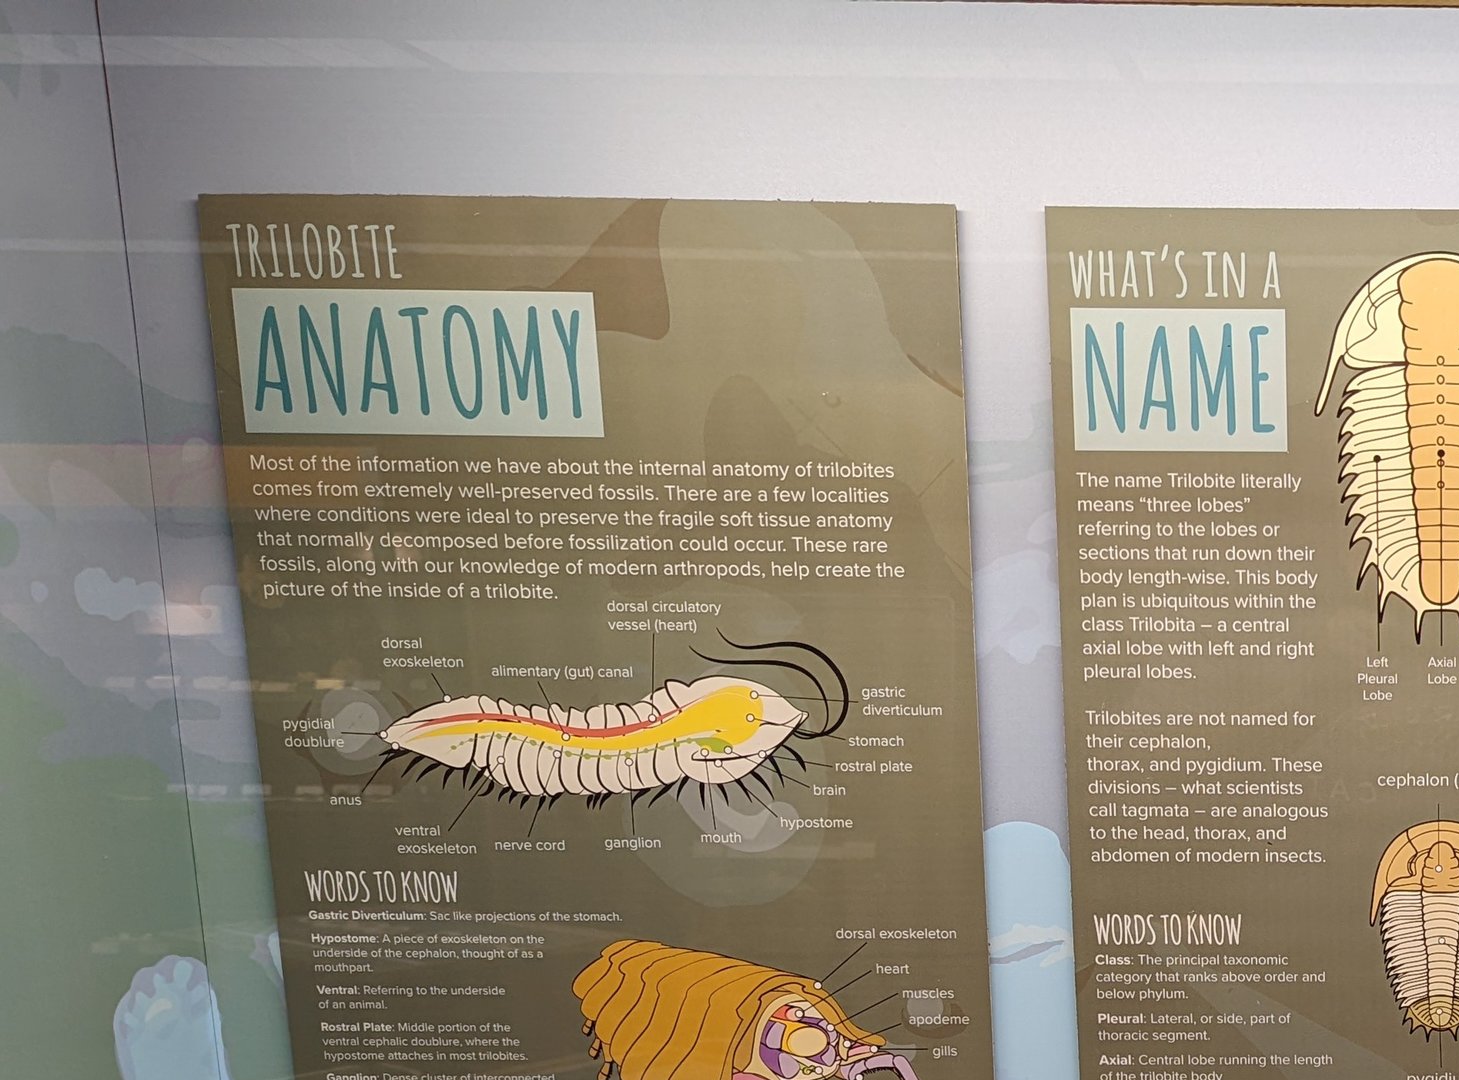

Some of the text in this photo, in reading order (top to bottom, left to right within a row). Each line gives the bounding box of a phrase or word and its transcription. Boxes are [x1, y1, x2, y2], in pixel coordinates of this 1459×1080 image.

[226, 223, 402, 279] TRILOBITE
[1069, 245, 1280, 299] WHAT'S IN A
[252, 303, 581, 423] ANATOMY
[1085, 322, 1275, 435] NAME
[250, 455, 894, 480] Most of the information we have about the internal anatomy of trilobites
[1076, 472, 1301, 492] The name Trilobite literally
[1078, 500, 1134, 511] means
[1079, 521, 1280, 540] referring to the lobes or
[607, 600, 721, 615] dorsal circulatory
[608, 619, 696, 633] vessel (heart)
[381, 637, 422, 648] dorsal
[383, 656, 463, 667] exoskeleton
[1367, 657, 1388, 667] Left
[1428, 657, 1456, 667] Axial
[492, 665, 632, 680] alimentary (gut) canal
[1358, 673, 1397, 684] Pleural
[1428, 674, 1457, 684] Lobe
[862, 687, 905, 700] gastric
[1364, 690, 1392, 700] Lobe
[863, 704, 942, 715] diverticulum
[282, 718, 335, 733] pygidial
[284, 736, 345, 749] doublure
[849, 736, 904, 746] stomach
[836, 761, 912, 773] rostral plate
[1378, 773, 1448, 789] cephalon
[813, 785, 845, 795] brain
[330, 797, 361, 805] anus
[780, 817, 853, 830] hypostome
[395, 825, 440, 836] ventral
[605, 837, 661, 850] ganglion
[701, 832, 741, 843] mouth
[398, 843, 477, 854] exoskeleton
[495, 840, 565, 850] nerve cord
[304, 870, 457, 903] WORDS TO KNOW
[309, 910, 622, 923] Gastric Diverticulum: Sac like projections of the stomach.
[836, 928, 956, 939] dorsal exoskeleton
[1094, 914, 1241, 945] WORDS TO KNOW
[1095, 954, 1288, 967] Class: The principal taxonomic
[876, 964, 909, 974] heart
[903, 988, 954, 998] muscles
[909, 1014, 969, 1027] apodeme
[933, 1046, 957, 1058] gills
